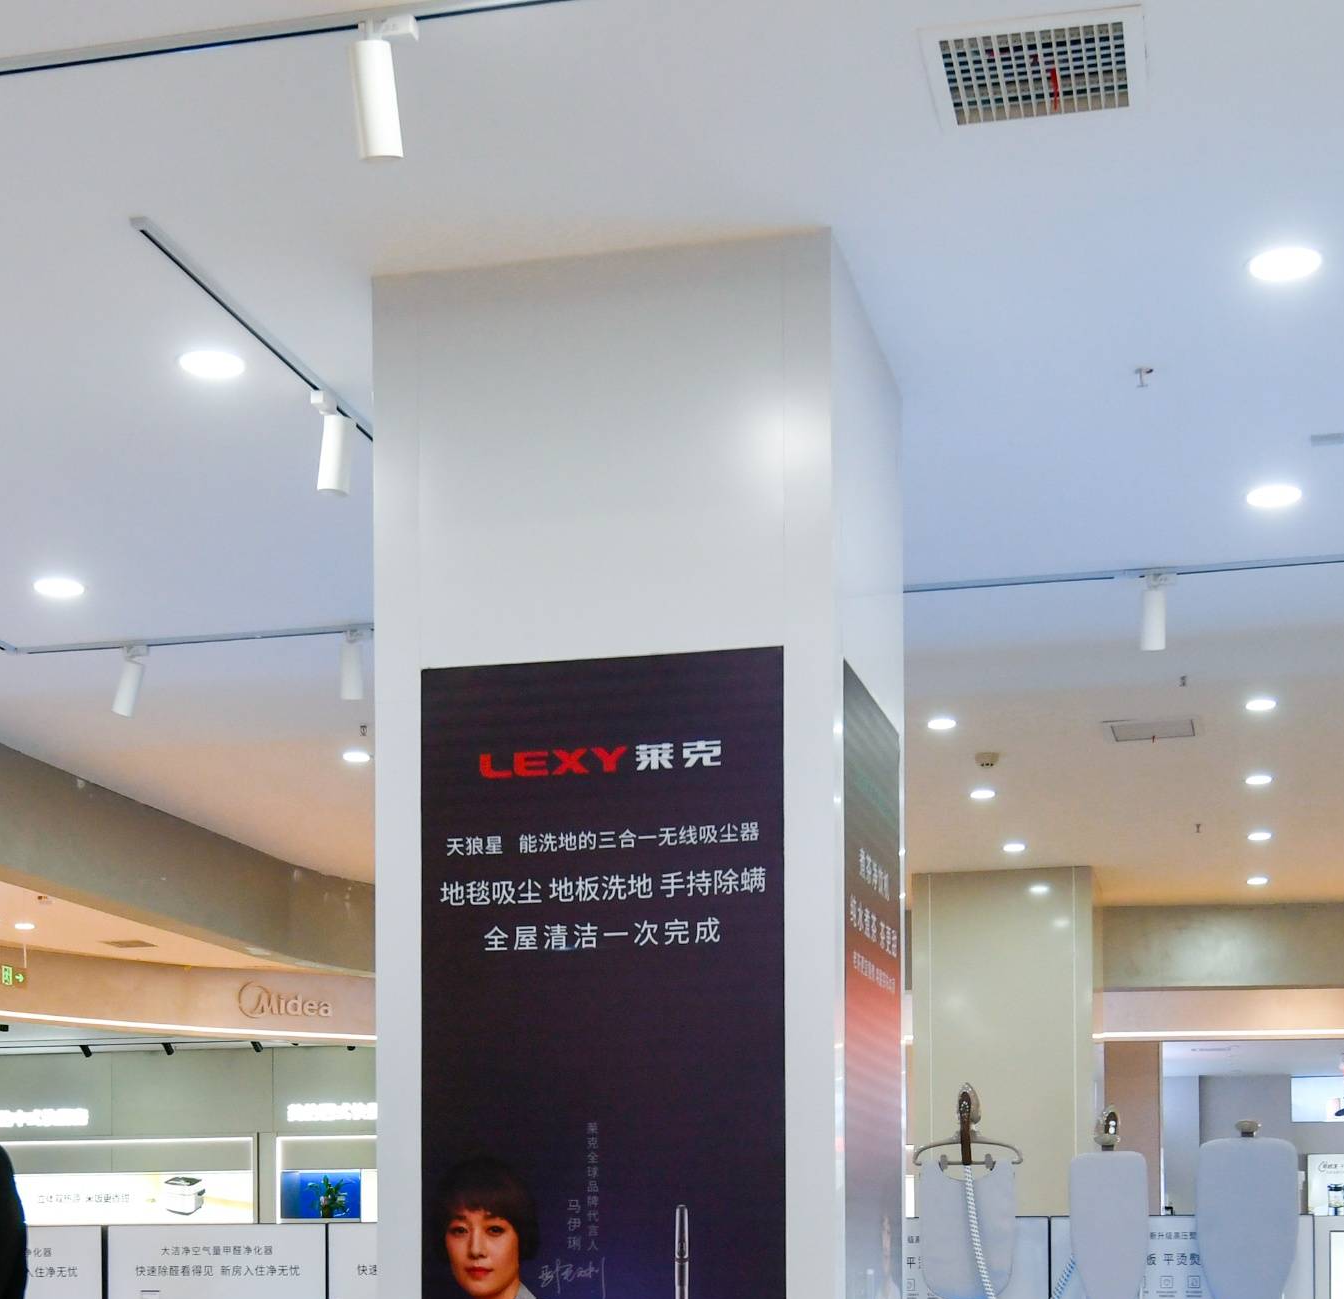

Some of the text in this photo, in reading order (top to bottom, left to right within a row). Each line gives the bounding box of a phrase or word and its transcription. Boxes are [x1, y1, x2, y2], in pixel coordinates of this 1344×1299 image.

[479, 739, 723, 779] LEXY 莱克
[446, 821, 760, 857] 天狼星 能洗地的三合一无线吸尘器
[439, 866, 767, 908] 地毯吸尘 地板洗地 手持除螨
[483, 917, 722, 953] 全屋清洁一次完成
[243, 983, 334, 1018] Midea
[587, 1122, 600, 1251] 莱克全球品牌代言人
